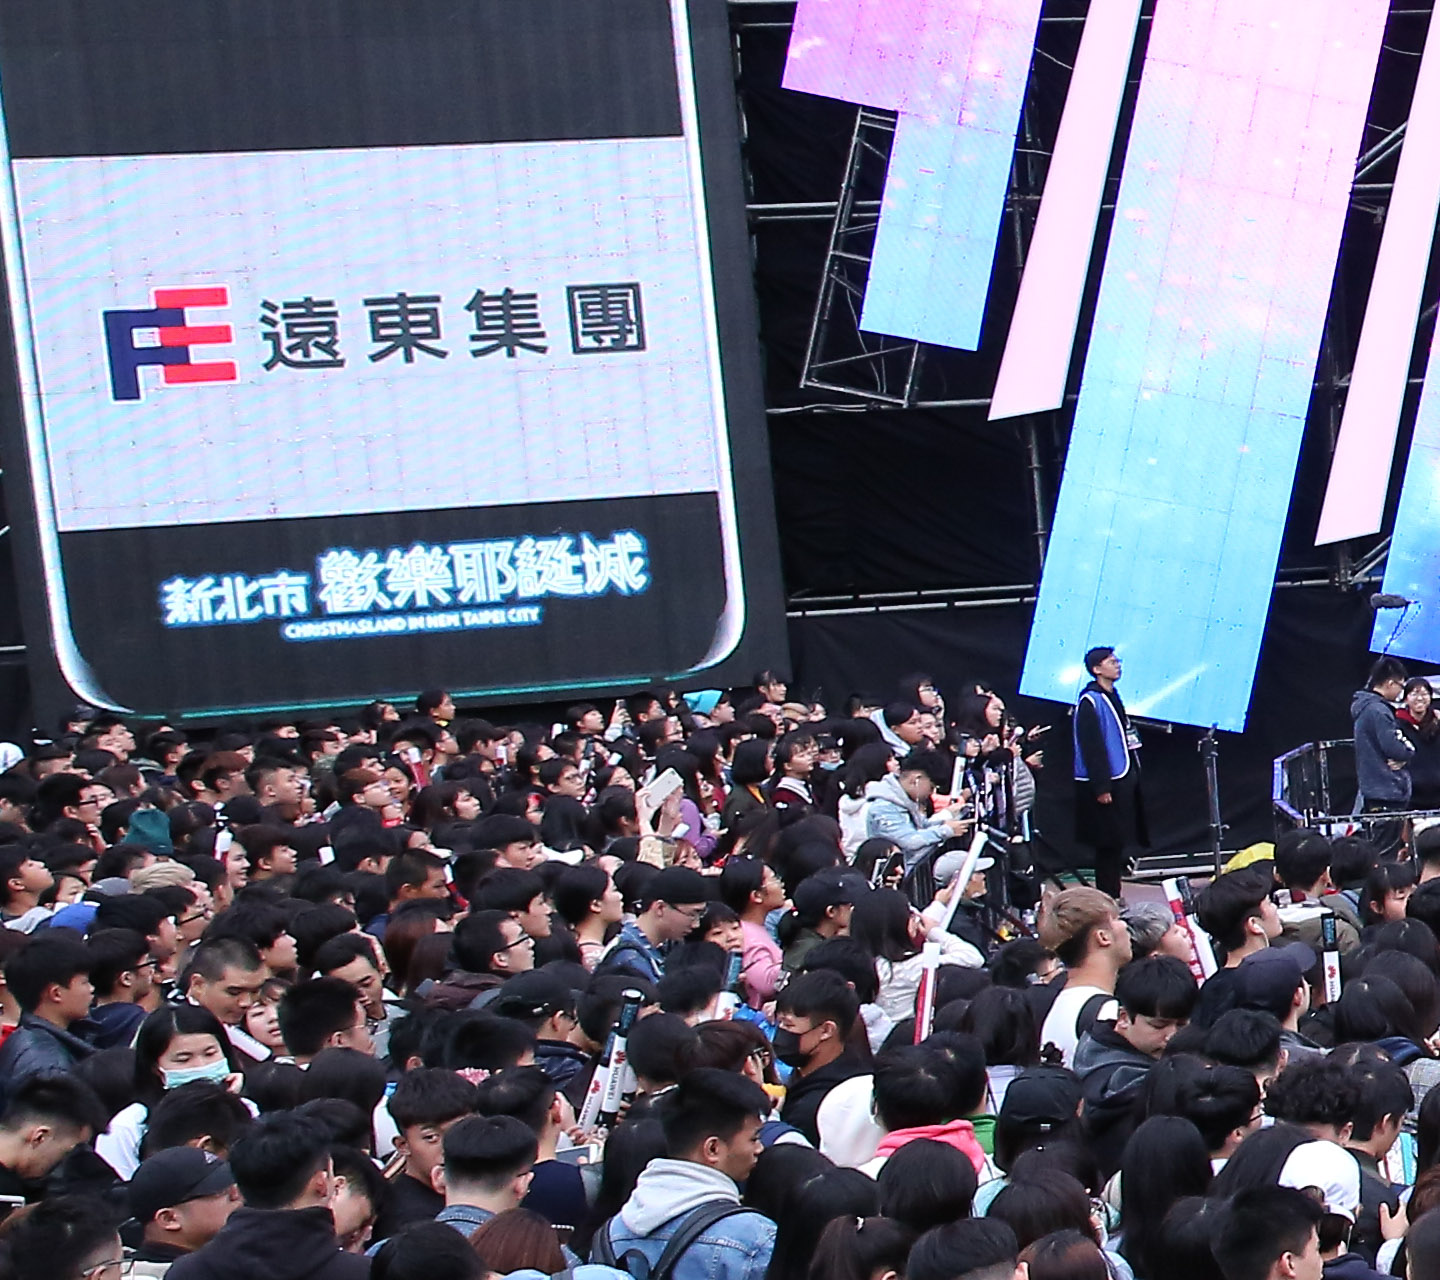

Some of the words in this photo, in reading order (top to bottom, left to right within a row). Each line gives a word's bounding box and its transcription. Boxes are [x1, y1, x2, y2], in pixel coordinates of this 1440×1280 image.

[259, 282, 646, 372] 遠東集團
[161, 570, 311, 626] 新北市
[317, 531, 649, 614] 歡樂耶誕城
[284, 615, 406, 640] CHRISTMASLAND
[408, 615, 423, 631] IN
[463, 610, 506, 628] TAIPEI
[508, 606, 540, 625] CITY
[608, 1067, 620, 1100] HUAWEI
